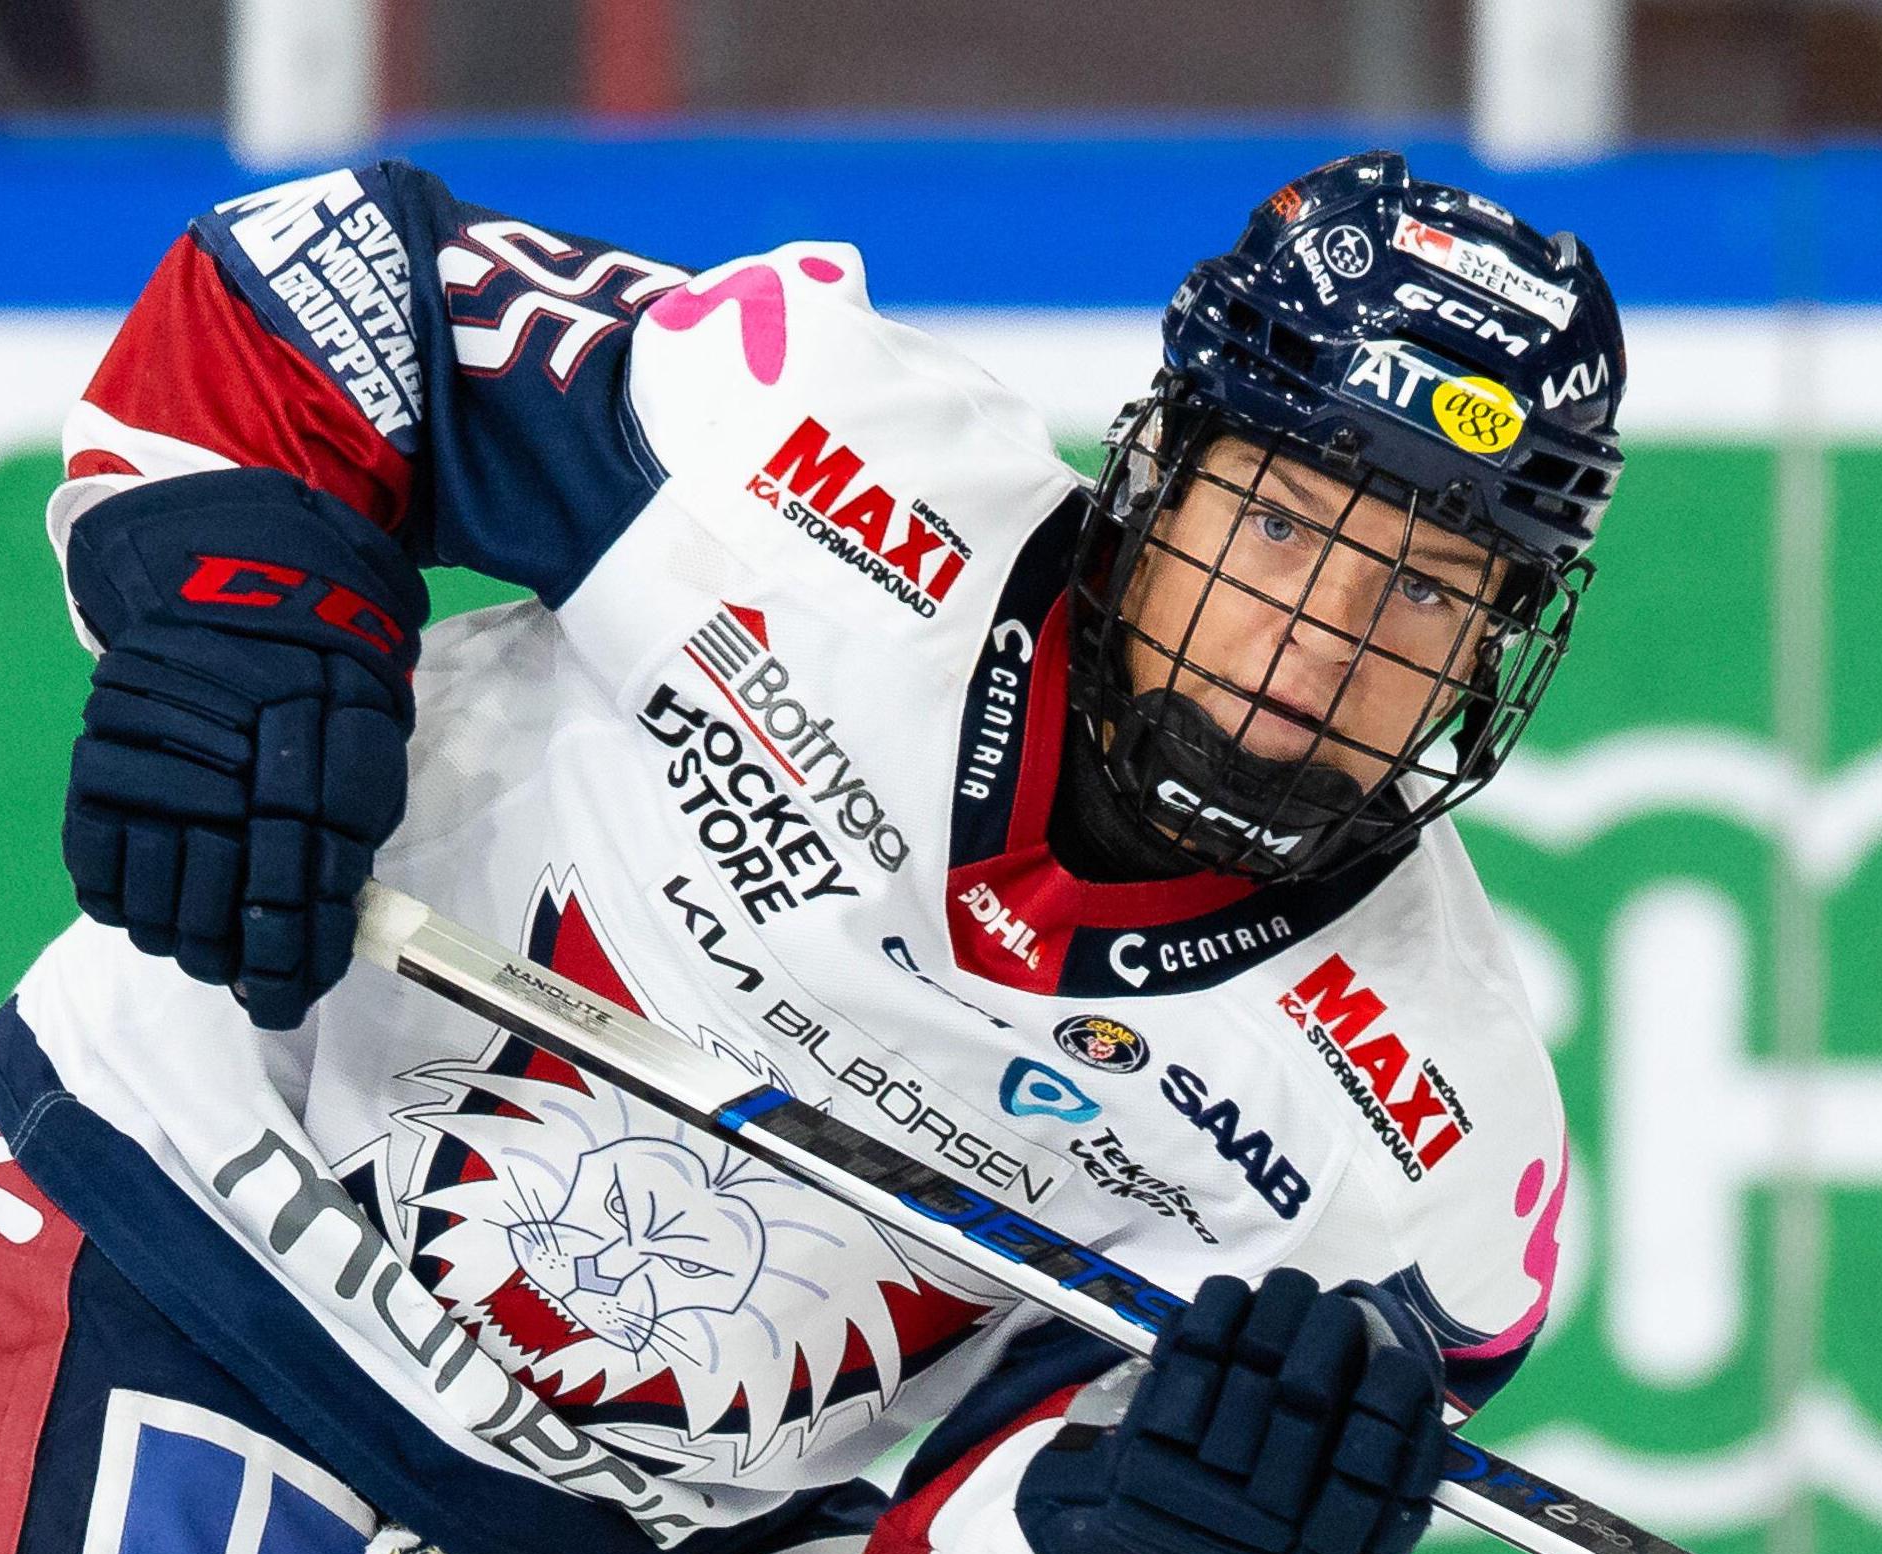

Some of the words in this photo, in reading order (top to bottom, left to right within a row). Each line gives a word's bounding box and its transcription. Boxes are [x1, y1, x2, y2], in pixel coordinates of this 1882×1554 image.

[1293, 227, 1339, 307] SUBARU
[1393, 282, 1531, 357] CCM
[1456, 261, 1511, 298] SPEL
[1461, 248, 1567, 313] SVENSKA
[269, 261, 413, 438] GRUPPEN
[1347, 350, 1436, 409] AT
[745, 473, 780, 511] ICA
[782, 500, 937, 619] STORMARKNAD
[763, 416, 966, 603] MAXI
[179, 554, 414, 688] CC
[636, 683, 861, 900] HOCKEY
[737, 657, 910, 872] Botrygg
[960, 667, 1018, 799] CENTRIA
[667, 748, 799, 925] STORE
[1157, 779, 1303, 855] CCM
[502, 962, 614, 1026] NANOLITE
[1159, 916, 1292, 972] CENTRIA
[1085, 1018, 1137, 1047] SAAB
[1292, 952, 1463, 1172] MAXI
[761, 1000, 1054, 1205] BILBÖRSEN
[1159, 1063, 1312, 1221] SAAB
[1306, 1024, 1423, 1183] STORMARKNAD
[1091, 1126, 1220, 1245] Tekniska
